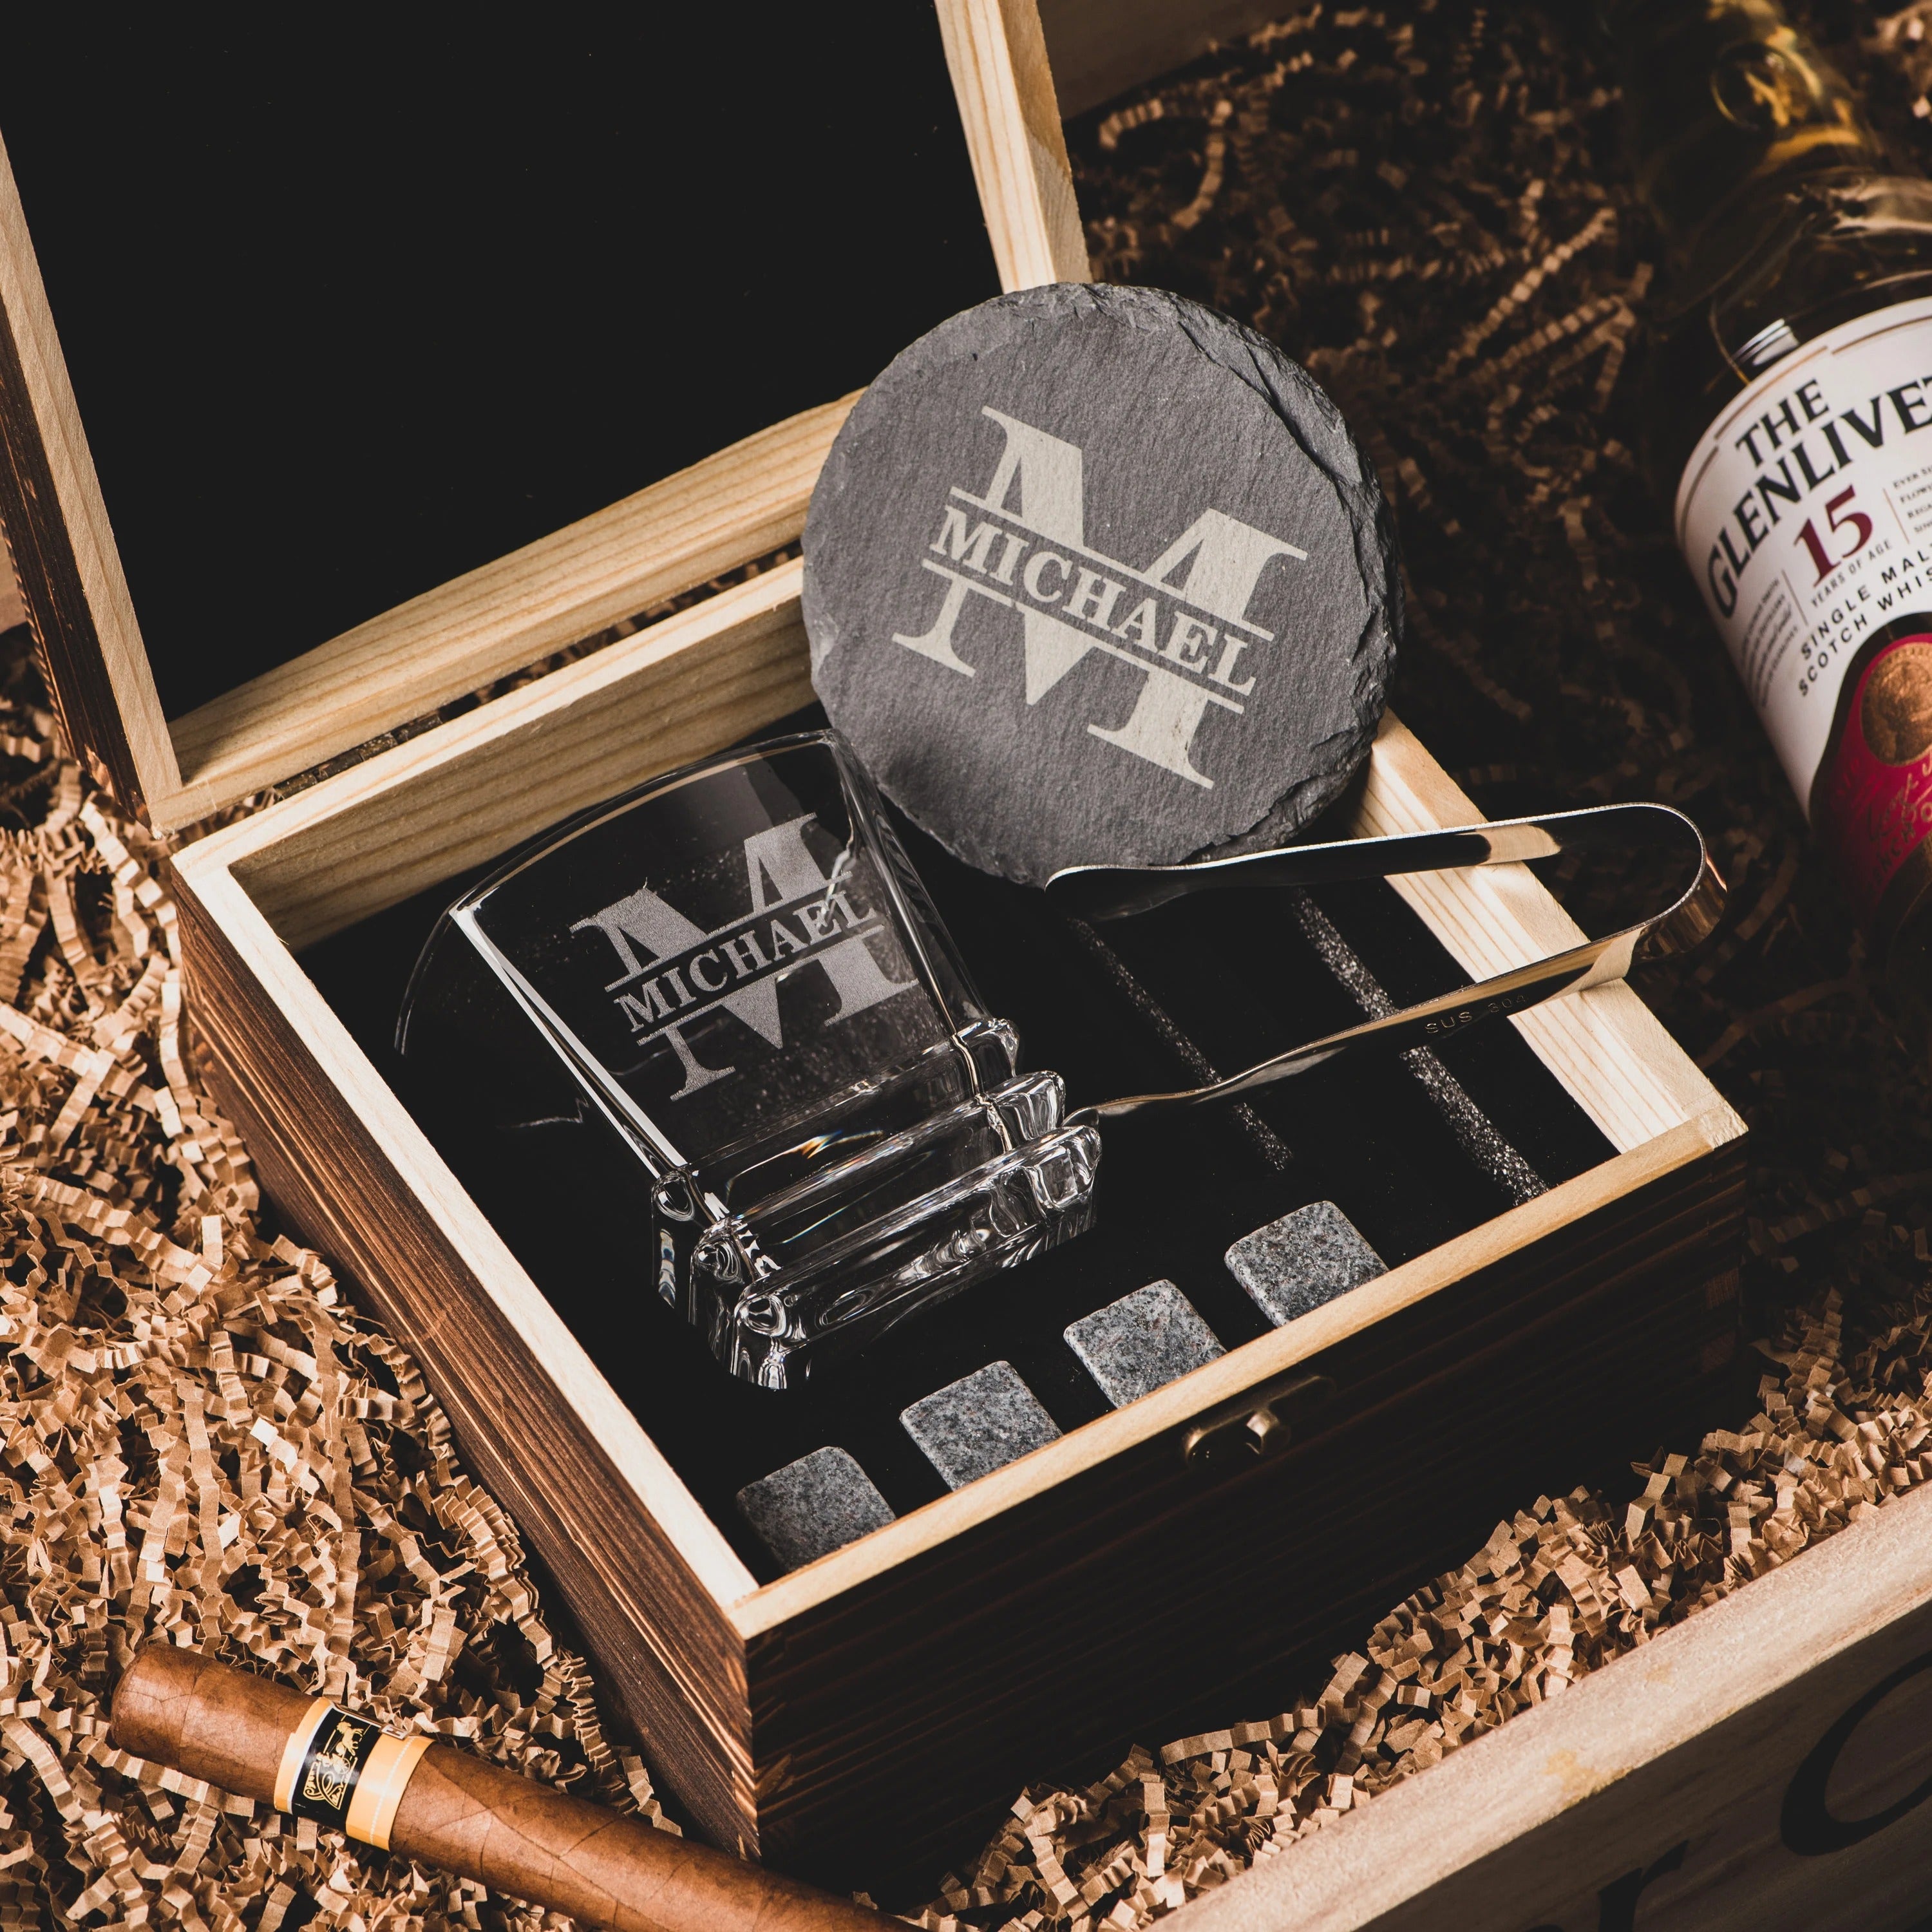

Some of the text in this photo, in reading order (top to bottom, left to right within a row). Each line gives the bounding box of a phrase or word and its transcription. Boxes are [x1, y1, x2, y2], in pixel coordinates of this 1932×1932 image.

[1735, 377, 1830, 468] THE
[1793, 484, 1873, 588] 15
[1810, 538, 1892, 608] YEARS OF AGE
[929, 504, 1257, 696] MICHAEL
[1800, 585, 1870, 660] SINGLE
[1881, 543, 1932, 584] MAL
[1798, 614, 1868, 697] SCOTCH
[613, 890, 877, 1034] MICHAEL
[1425, 995, 1526, 1034] SUS 304
